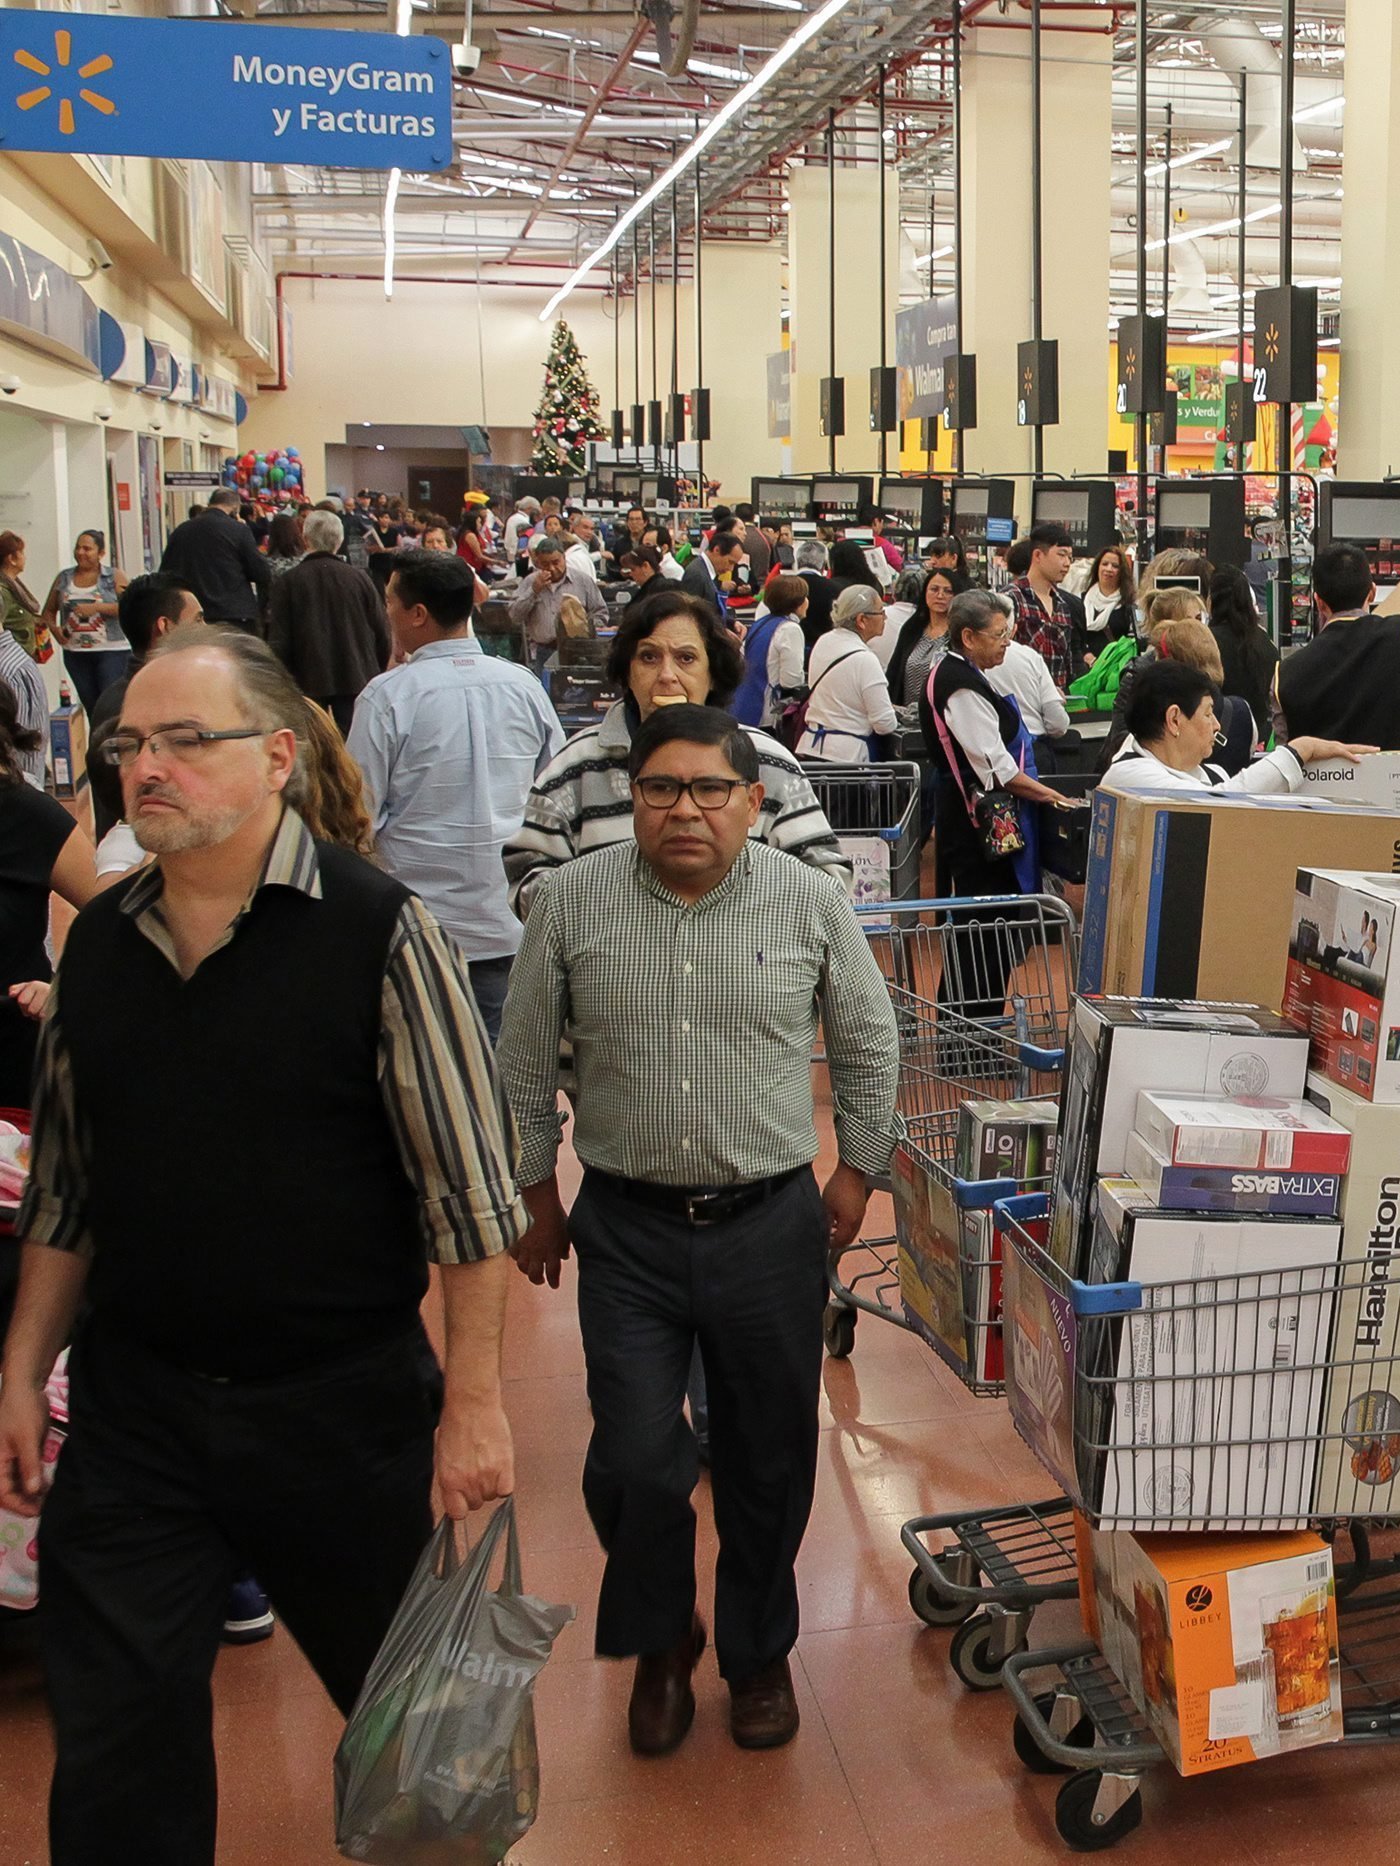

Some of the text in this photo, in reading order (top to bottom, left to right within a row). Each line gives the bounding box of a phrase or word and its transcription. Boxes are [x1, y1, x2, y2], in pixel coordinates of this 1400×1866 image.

[233, 55, 434, 95] MoneyGram
[272, 103, 436, 137] y Facturas
[1117, 383, 1127, 413] 20
[1253, 367, 1267, 402] 22
[1302, 768, 1355, 782] Polaroid
[1356, 1176, 1400, 1346] Hamilton
[1050, 1297, 1072, 1354] NUEVO
[1179, 1612, 1222, 1629] LIBBEY
[1188, 1747, 1243, 1765] STRATUS
